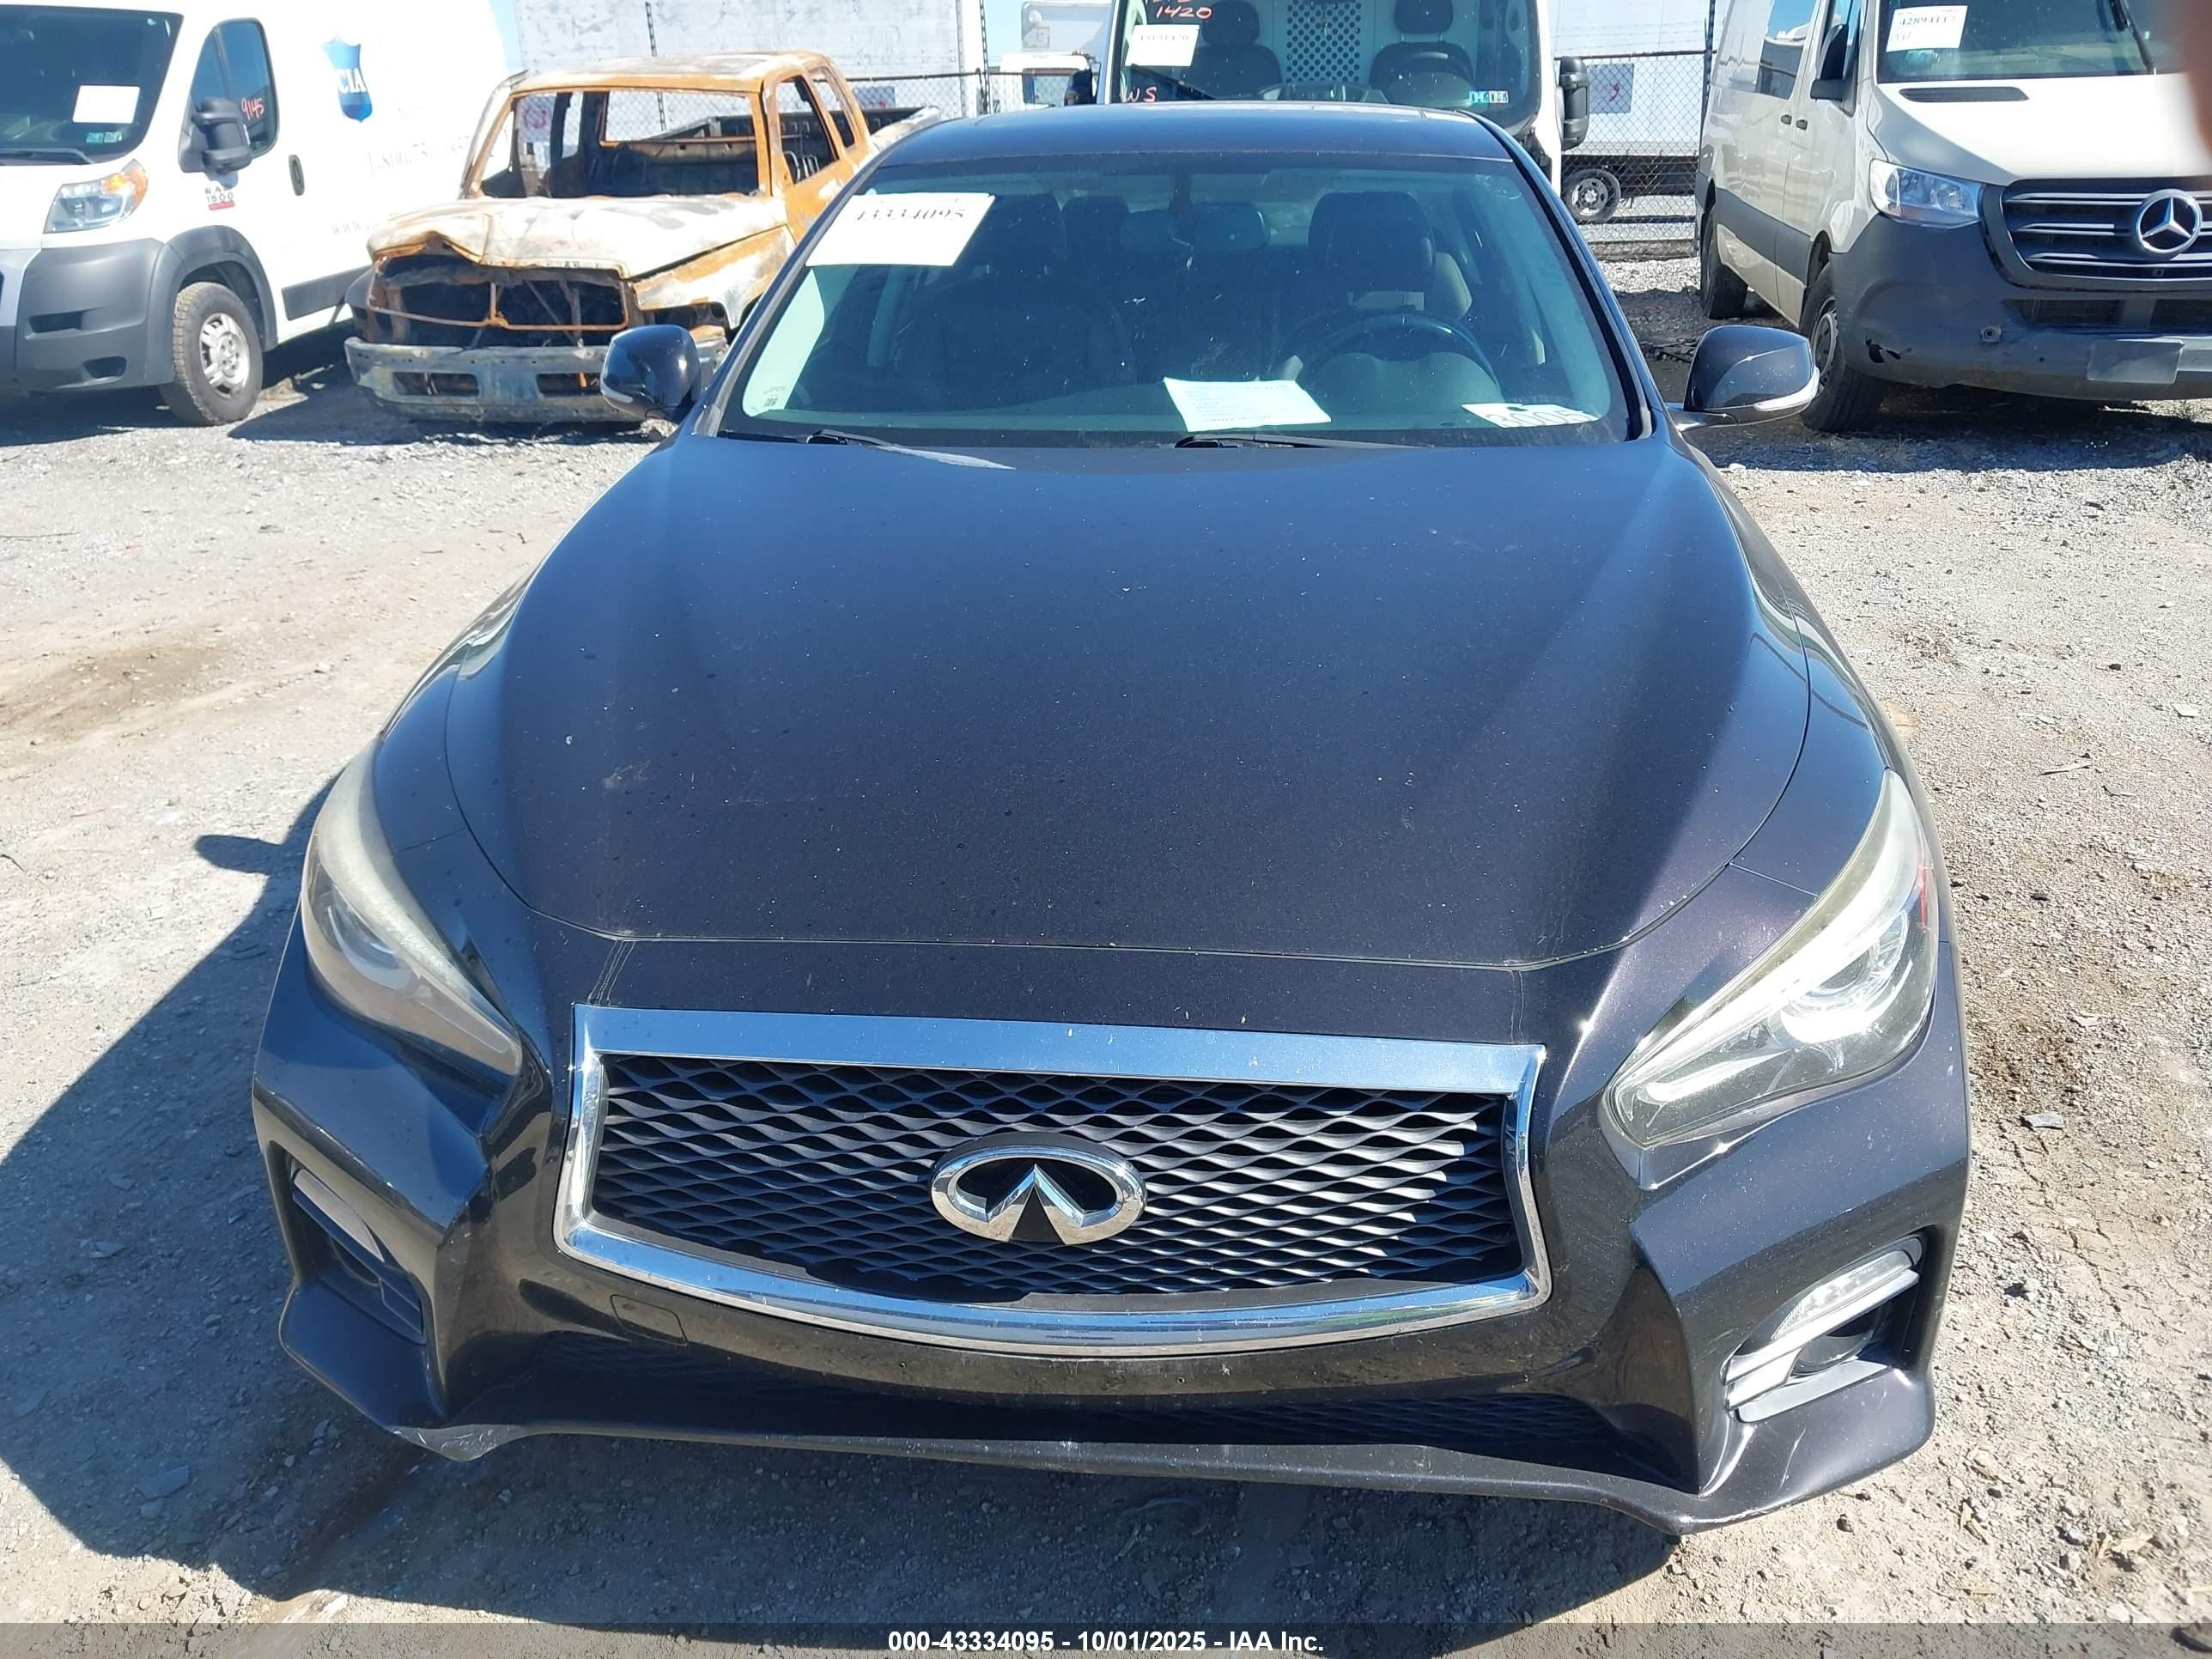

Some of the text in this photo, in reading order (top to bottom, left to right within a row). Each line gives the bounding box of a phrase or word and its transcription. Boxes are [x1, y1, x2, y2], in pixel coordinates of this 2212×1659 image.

[1156, 5, 1212, 19] 1420
[240, 97, 264, 121] 9145
[205, 191, 234, 204] 1500
